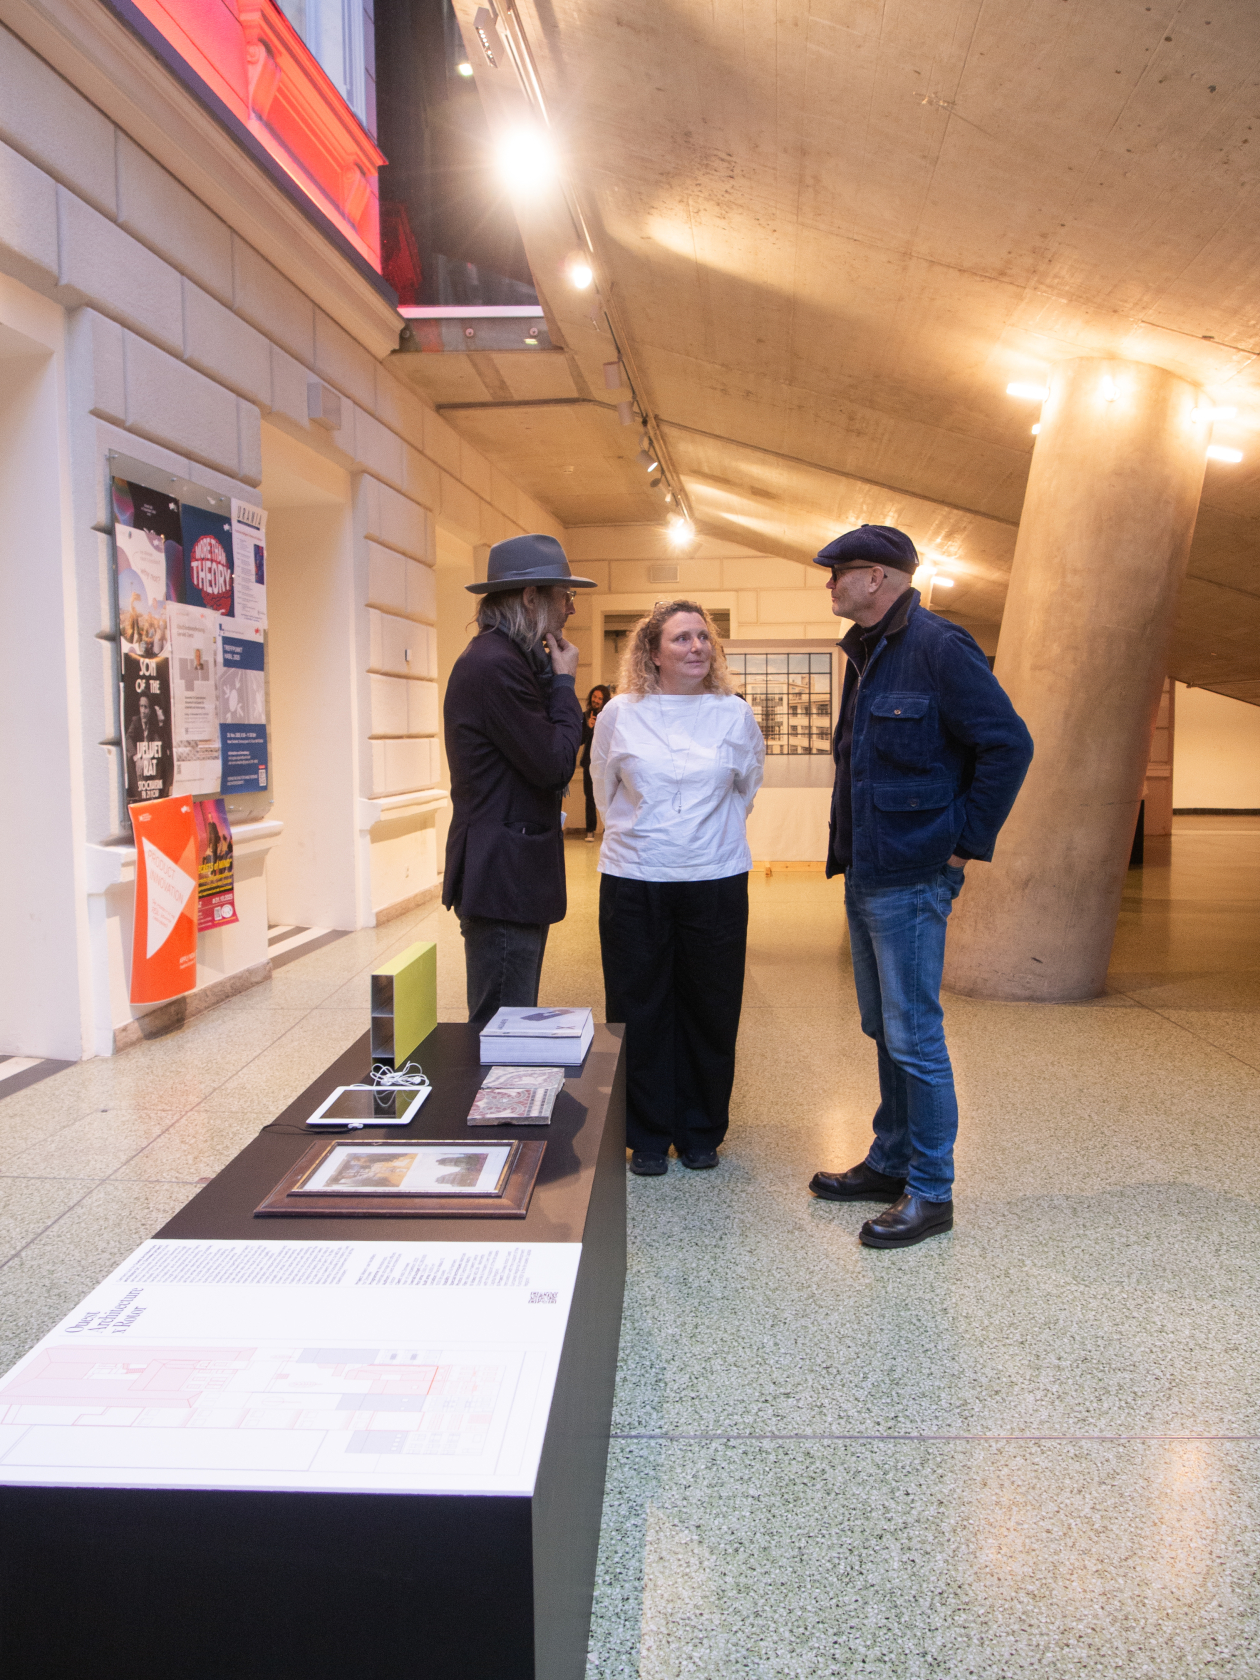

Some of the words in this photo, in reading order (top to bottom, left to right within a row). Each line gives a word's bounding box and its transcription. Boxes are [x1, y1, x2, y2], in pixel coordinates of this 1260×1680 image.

[237, 505, 262, 527] URANIA
[195, 537, 212, 560] MORE
[211, 538, 227, 566] THAN
[190, 560, 231, 595] THEORY
[139, 658, 157, 676] SON
[135, 679, 146, 693] OF
[149, 679, 160, 694] THE
[136, 741, 162, 758] VELVET
[143, 759, 157, 776] RAT
[147, 849, 176, 879] PRODUCT
[149, 868, 185, 905] INNOVATION
[64, 1310, 101, 1334] Ouest
[87, 1287, 145, 1334] Architecture
[111, 1306, 148, 1328] Rotor
